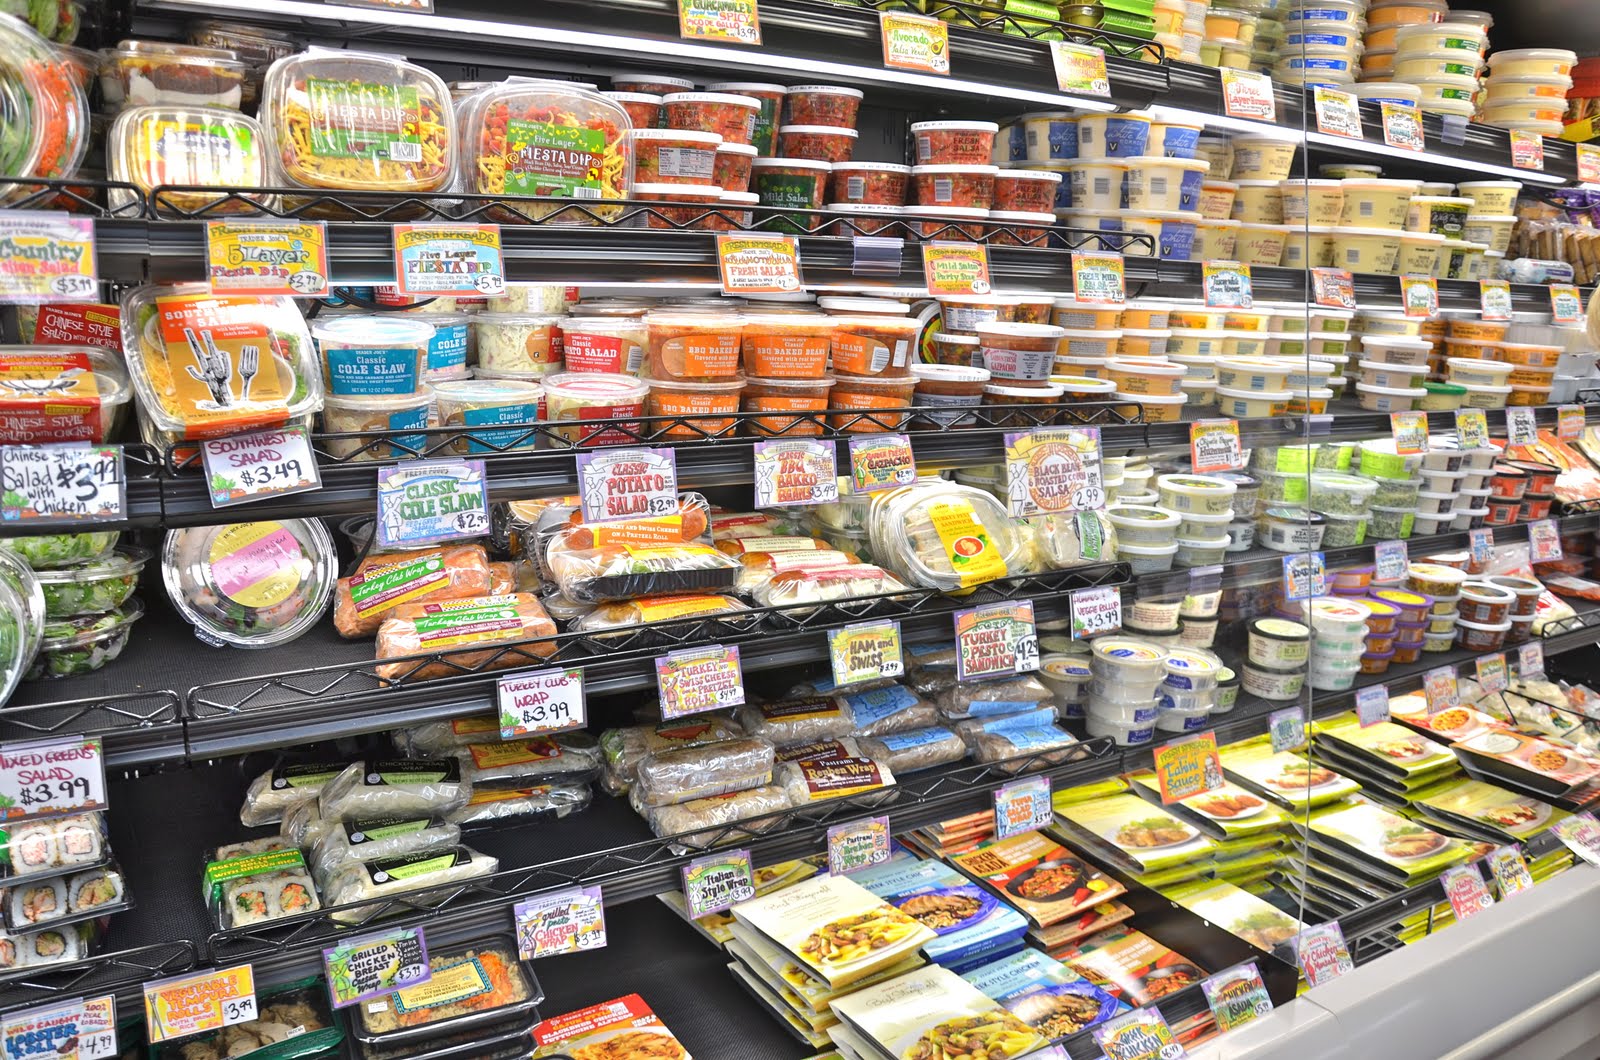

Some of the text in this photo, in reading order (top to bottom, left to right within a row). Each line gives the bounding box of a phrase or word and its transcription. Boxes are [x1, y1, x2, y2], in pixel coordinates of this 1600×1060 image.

[893, 29, 929, 46] Avocado
[552, 138, 577, 148] Layer
[520, 148, 593, 166] FIESTA DIP
[763, 191, 809, 203] Mild Salsa
[228, 244, 311, 265] 5 Layer
[445, 250, 477, 261] Layer
[211, 264, 290, 279] Fiesta Dip
[407, 260, 492, 274] FIESTA DIP
[57, 278, 93, 294] $3.99
[46, 315, 114, 338] CHINESE STYLE
[88, 335, 119, 350] CHICKEN
[438, 342, 461, 352] COLE
[572, 339, 592, 348] Classic
[356, 356, 387, 365] Classic
[584, 349, 618, 361] SALAD
[688, 347, 706, 357] BBQ
[776, 348, 803, 358] BAKED
[338, 364, 406, 376] COLE SLAW
[500, 411, 524, 423] Classic
[662, 405, 710, 415] BBQ BAKED
[52, 414, 84, 429] STYLE
[208, 432, 288, 455] SOUTHWEST
[1031, 434, 1051, 444] FRESH
[4, 450, 50, 463] Chinese
[229, 449, 283, 468] SALAD
[241, 459, 303, 487] $3.49
[611, 463, 649, 477] CLASSIC
[1034, 464, 1060, 478] BLACK
[1, 466, 54, 493] Salad
[607, 473, 665, 496] POTATO
[778, 473, 817, 488] BAKED
[1035, 474, 1067, 487] ROASTED
[28, 487, 57, 501] with
[406, 480, 459, 500] CLASSIC
[778, 486, 812, 503] BEANS
[1039, 484, 1070, 499] SALSA
[1077, 489, 1099, 507] 2.99
[34, 499, 88, 515] Chicken
[400, 493, 484, 521] COLE SLAW
[608, 495, 649, 516] SALAD
[649, 499, 675, 514] $2.99
[457, 514, 489, 530] $2.99
[358, 580, 385, 598] Turkey
[385, 570, 404, 585] Club
[405, 566, 426, 579] Wrap
[477, 611, 499, 622] Wrap
[1077, 606, 1099, 616] VEGGIE
[1087, 610, 1119, 629] $3.99
[961, 628, 1007, 646] TURKEY
[849, 639, 895, 655] HAM and
[970, 642, 1006, 659] PESTO
[680, 661, 719, 678] TURKEY
[849, 652, 883, 671] SWISS
[963, 654, 1015, 675] SANDWICH
[500, 677, 570, 695] TURKEY CLUB
[679, 670, 737, 690] SWISS CHEESE
[698, 680, 736, 694] PRETZEL
[514, 692, 550, 709] WRAP
[684, 694, 713, 708] ROLL
[522, 703, 570, 725] $3.99
[45, 746, 94, 764] GREENS
[819, 758, 853, 768] Pastrami
[379, 760, 413, 769] CHICKEN
[401, 764, 424, 772] WRAP
[807, 762, 876, 781] Reuben Wrap
[1164, 757, 1200, 777] Tahini
[17, 767, 75, 785] SALAD
[1166, 774, 1202, 791] Sauce
[20, 776, 91, 806] $3.99
[846, 833, 873, 845] Pastrami
[261, 850, 299, 862] TEMPURA
[960, 850, 999, 868] CHICKEN
[973, 859, 1011, 874] ASADA
[704, 871, 735, 884] Italian
[701, 877, 749, 900] Style Wrap
[541, 903, 571, 926] grilled
[535, 923, 579, 942] CHICKEN
[546, 917, 570, 931] pesto
[539, 935, 568, 949] WRAP
[351, 945, 389, 962] GRILLED
[1310, 945, 1338, 962] Chicken
[348, 952, 396, 973] CHICKEN
[354, 961, 391, 979] BREAST
[399, 964, 421, 980] $3.99
[988, 960, 1041, 986] STYLE CHICKEN
[160, 974, 237, 1000] VEGETABLE
[357, 980, 382, 994] Wrap
[1223, 983, 1255, 1001] CHICKEN
[168, 988, 239, 1011] TEMPURA
[1228, 998, 1254, 1017] ASADA
[83, 1013, 102, 1021] REAL
[168, 1002, 213, 1022] ROLLS
[6, 1014, 82, 1037] WILD CAUGHT
[169, 1018, 190, 1027] WITH
[180, 1022, 196, 1030] RICE
[541, 1021, 592, 1040] BLACKENED
[543, 1012, 634, 1045] FETTUCCINE ALFREDO
[6, 1021, 80, 1052] LOBSTER
[1118, 1027, 1146, 1046] GREEK
[1121, 1033, 1165, 1058] CHICKEN
